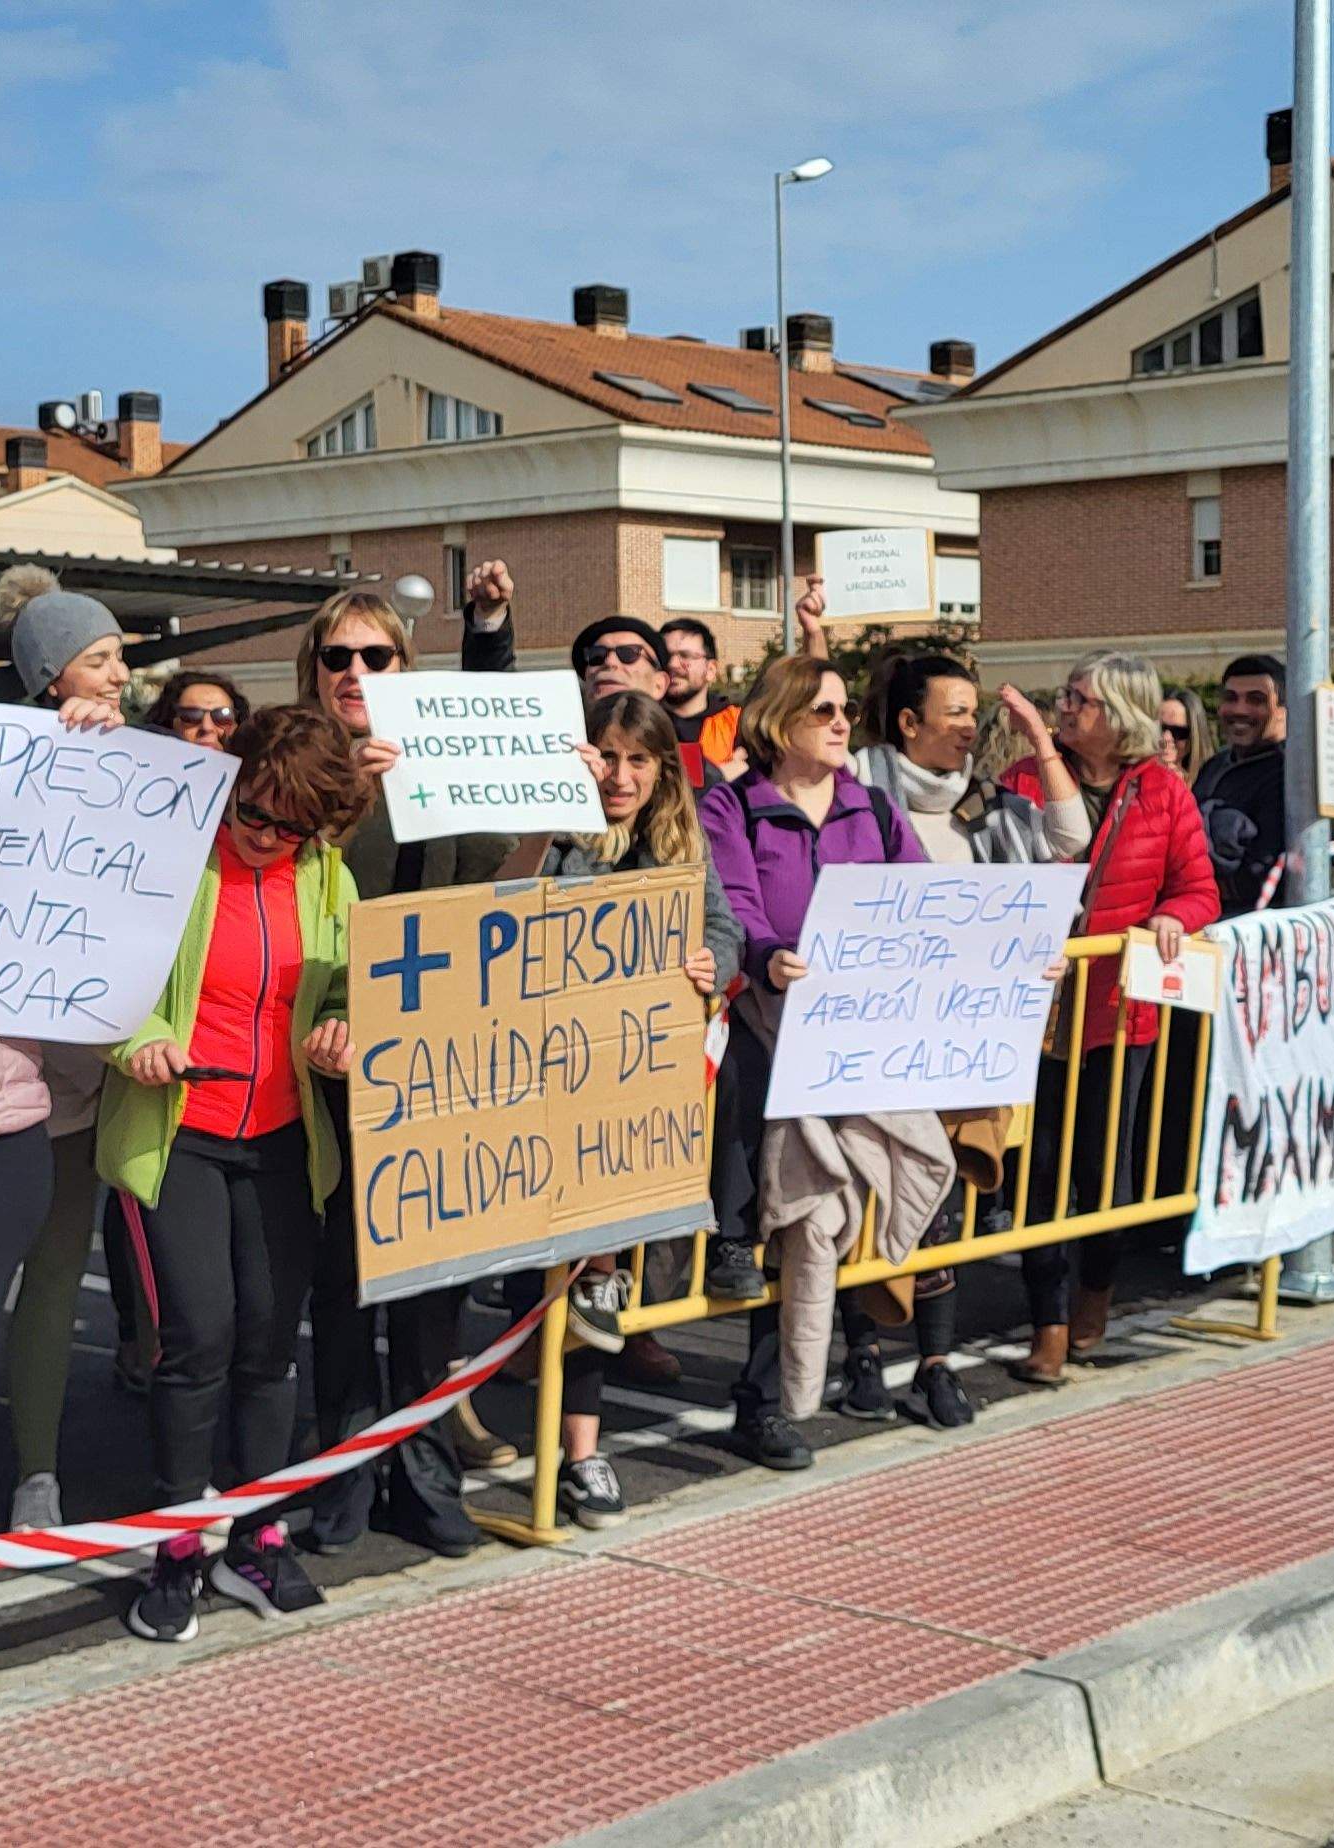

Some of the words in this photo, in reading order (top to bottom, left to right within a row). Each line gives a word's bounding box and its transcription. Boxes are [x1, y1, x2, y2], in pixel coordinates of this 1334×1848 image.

[416, 697, 542, 718] MEJORES
[402, 734, 574, 757] HOSPITALES
[448, 783, 588, 805] RECURSOS
[854, 876, 1047, 925] HUESCA
[807, 929, 957, 972] NECESITA
[991, 932, 1055, 970] UNA
[803, 977, 921, 1026] ATENCIÓN
[937, 976, 1052, 1028] URGENTE
[362, 1018, 591, 1131] SANIDAD
[619, 1003, 677, 1084] DE
[807, 1050, 875, 1090] DE
[881, 1038, 1019, 1082] CALIDAD
[577, 1101, 705, 1186] HUMANA
